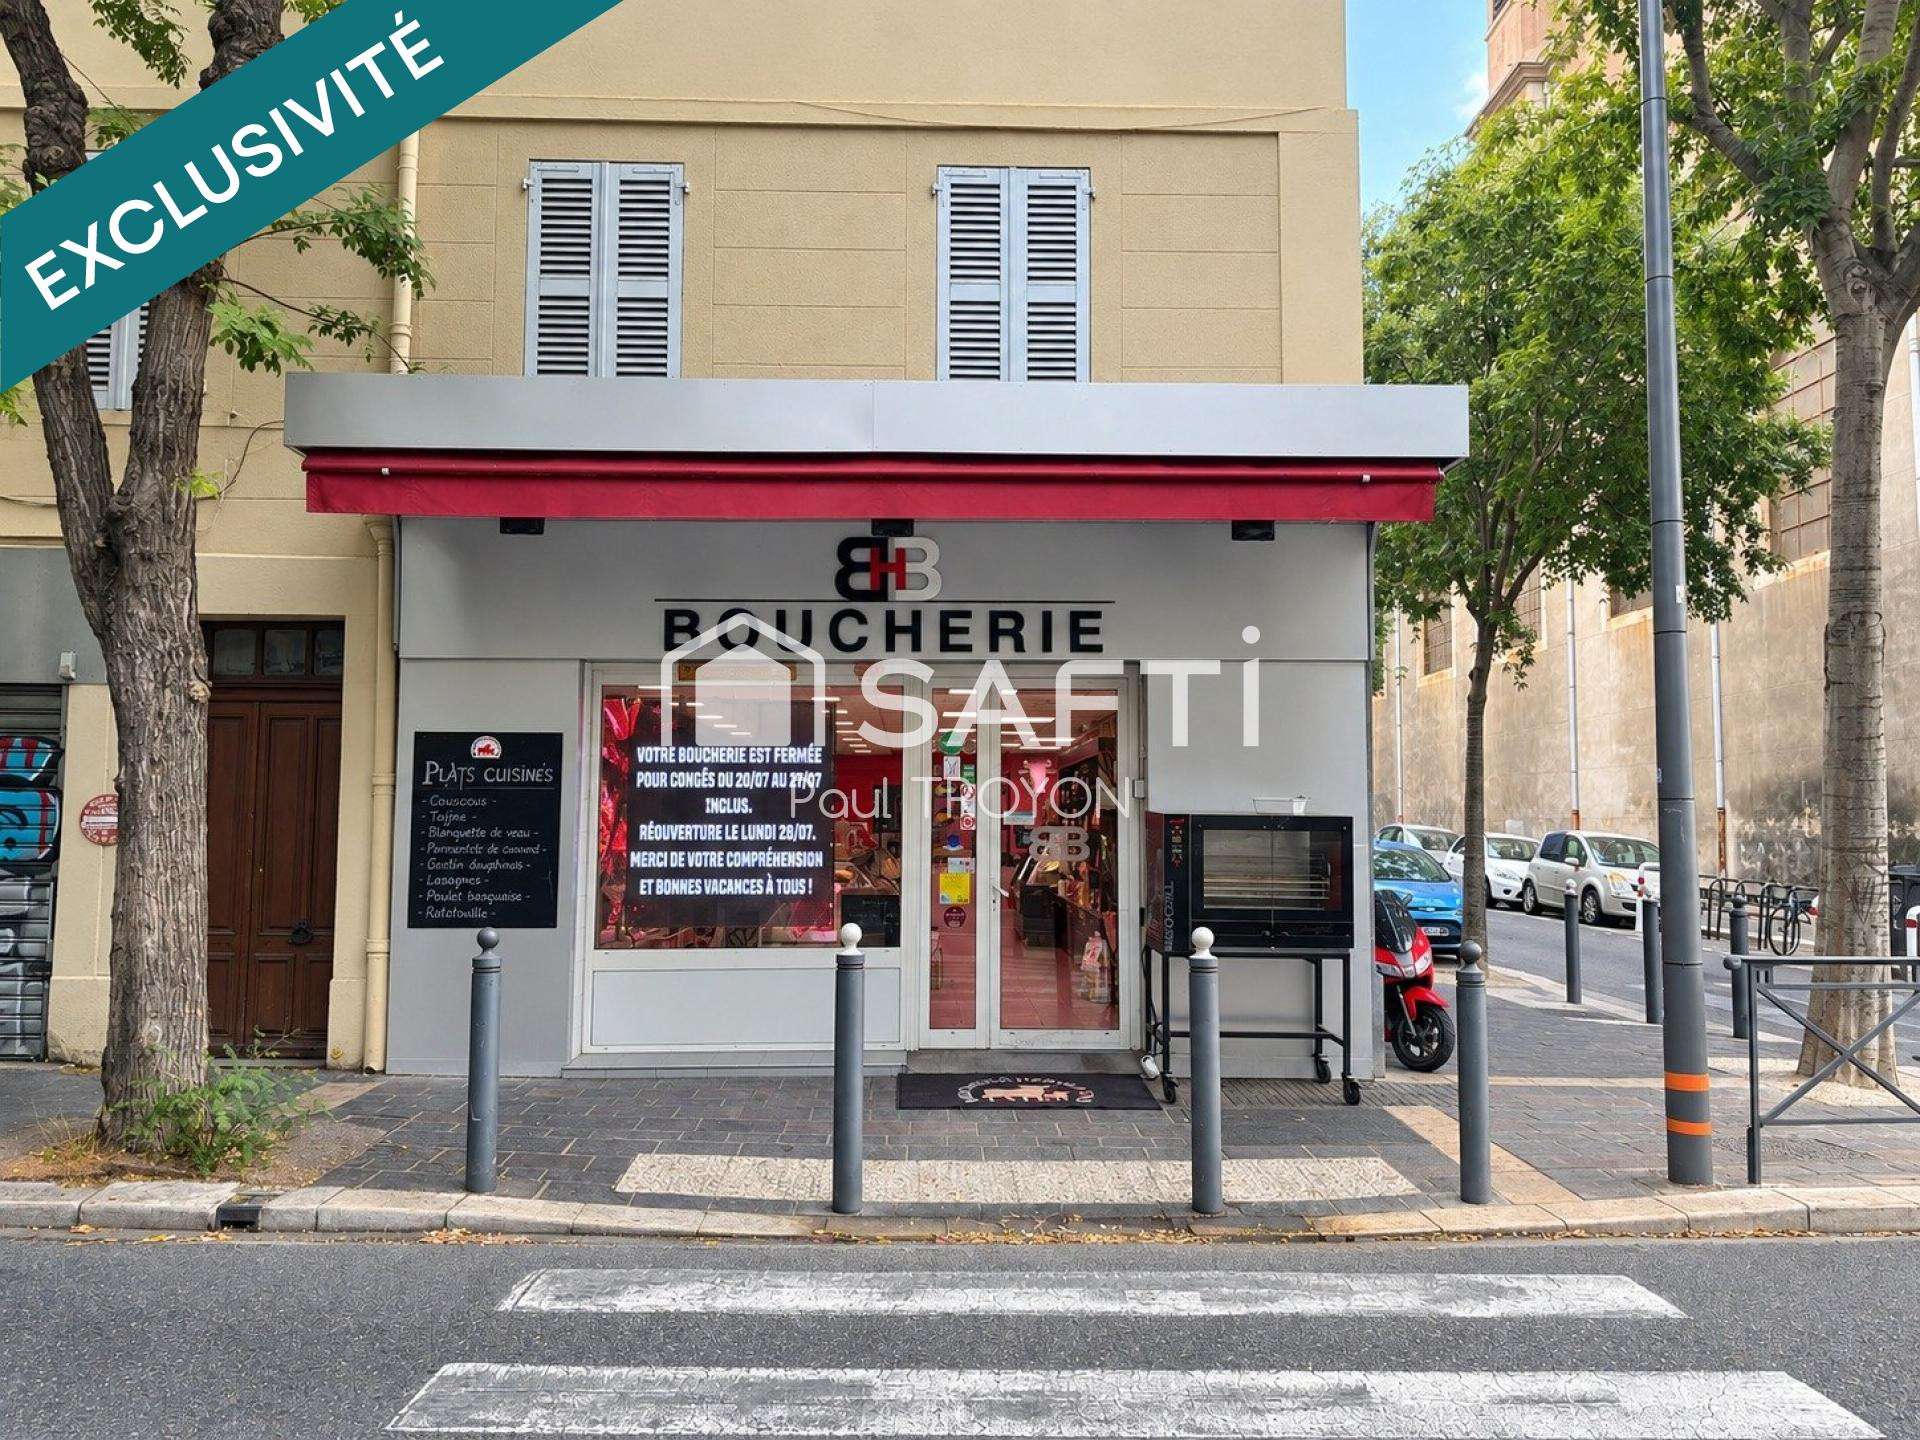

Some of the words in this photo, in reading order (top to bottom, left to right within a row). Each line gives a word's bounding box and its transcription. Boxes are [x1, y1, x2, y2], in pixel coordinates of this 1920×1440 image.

[664, 608, 1104, 653] BOUCHERIE
[637, 746, 676, 763] VOTRE
[678, 746, 746, 763] BOUCHERIE
[749, 746, 771, 763] EST
[774, 742, 822, 763] FERMÉE
[636, 771, 668, 788] POUR
[670, 767, 715, 788] CONGÉS
[718, 771, 734, 788] DU
[736, 771, 768, 790] 20/07
[771, 771, 787, 788] AU
[429, 794, 487, 807] Couscous
[705, 797, 752, 814] INCLUS.
[490, 827, 502, 838] de
[639, 820, 723, 841] RÉOUVERTURE
[725, 824, 739, 841] LE
[740, 824, 776, 841] LUNDI
[778, 824, 817, 842] 28/07.
[630, 851, 668, 868] MERCI
[670, 851, 685, 868] DE
[686, 851, 724, 868] VOTRE
[726, 846, 823, 868] COMPRÉHENSION
[639, 878, 654, 895] ET
[655, 878, 701, 895] BONNES
[704, 878, 765, 895] VACANCES
[765, 872, 774, 895] À
